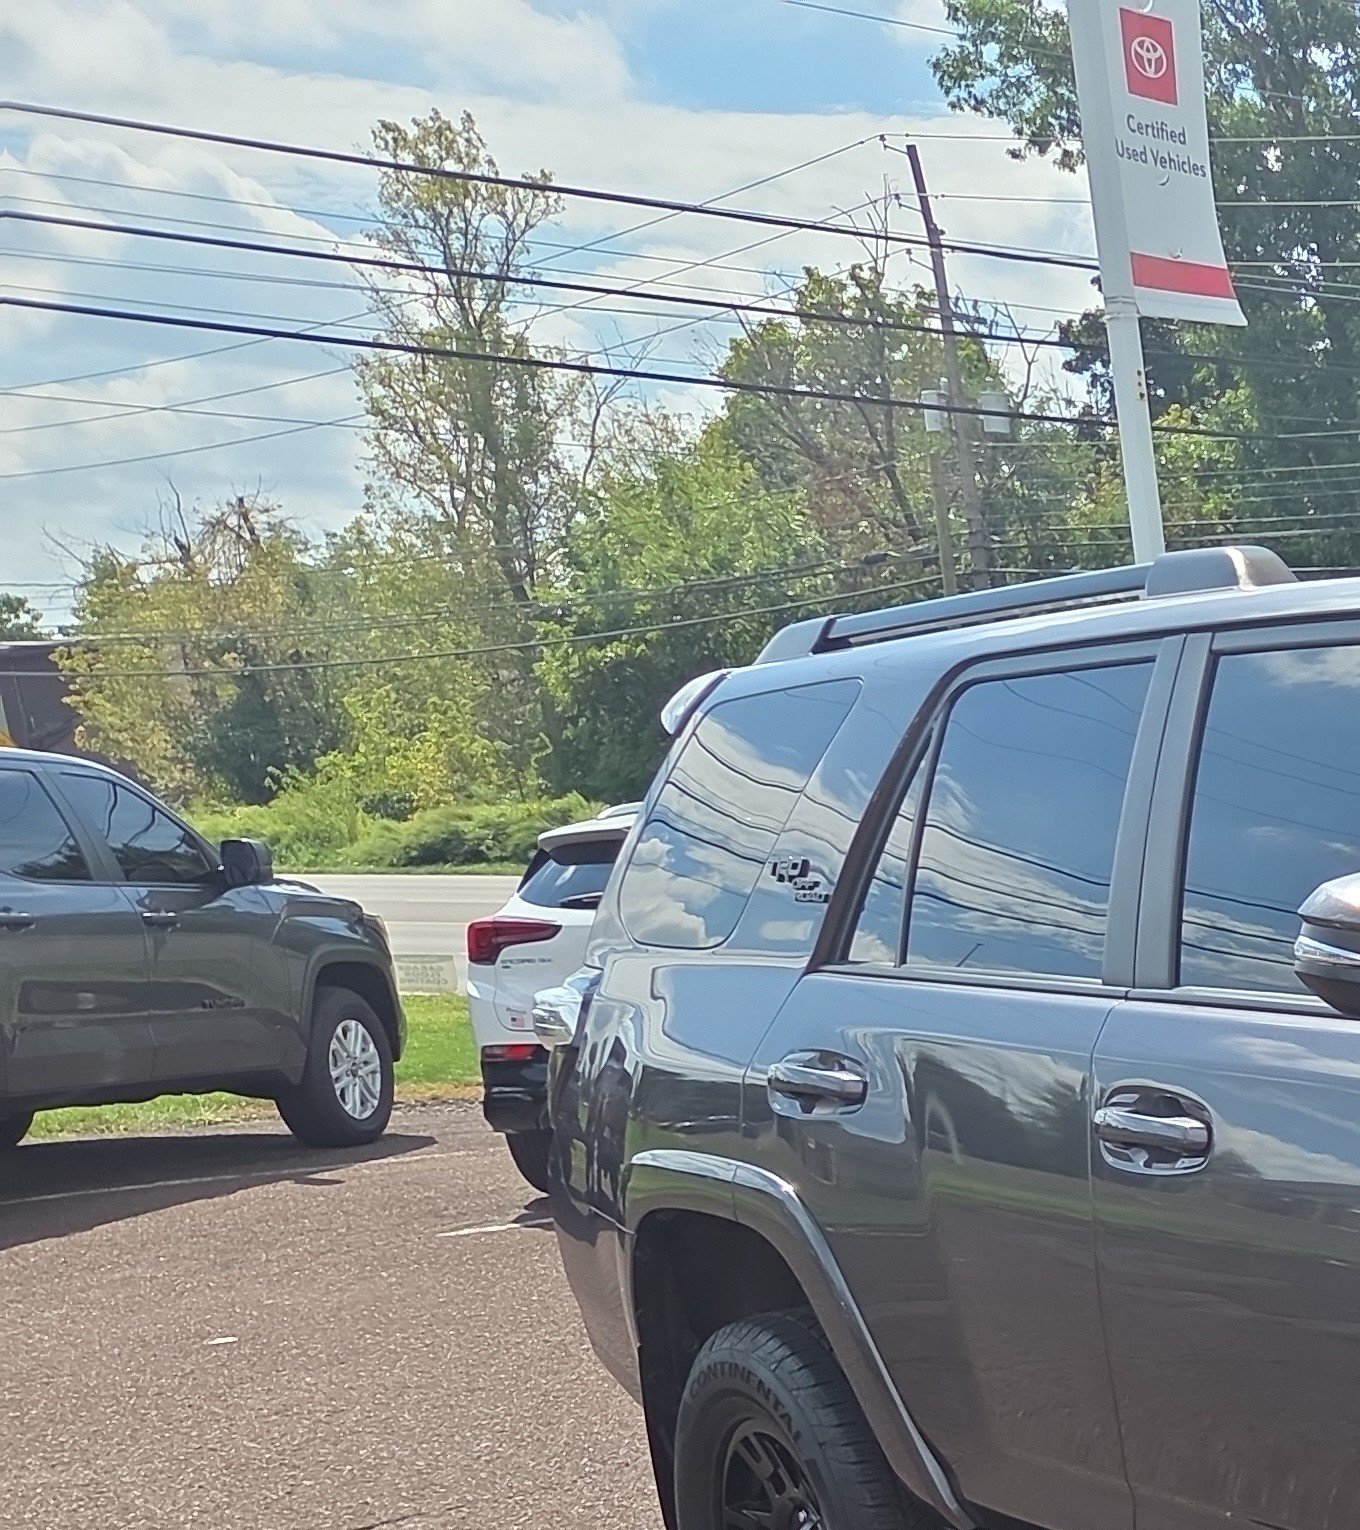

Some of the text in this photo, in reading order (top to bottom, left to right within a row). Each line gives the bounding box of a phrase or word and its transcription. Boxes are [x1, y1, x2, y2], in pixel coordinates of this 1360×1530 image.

[1126, 114, 1188, 146] Certified
[1115, 139, 1207, 178] Used Vehicles
